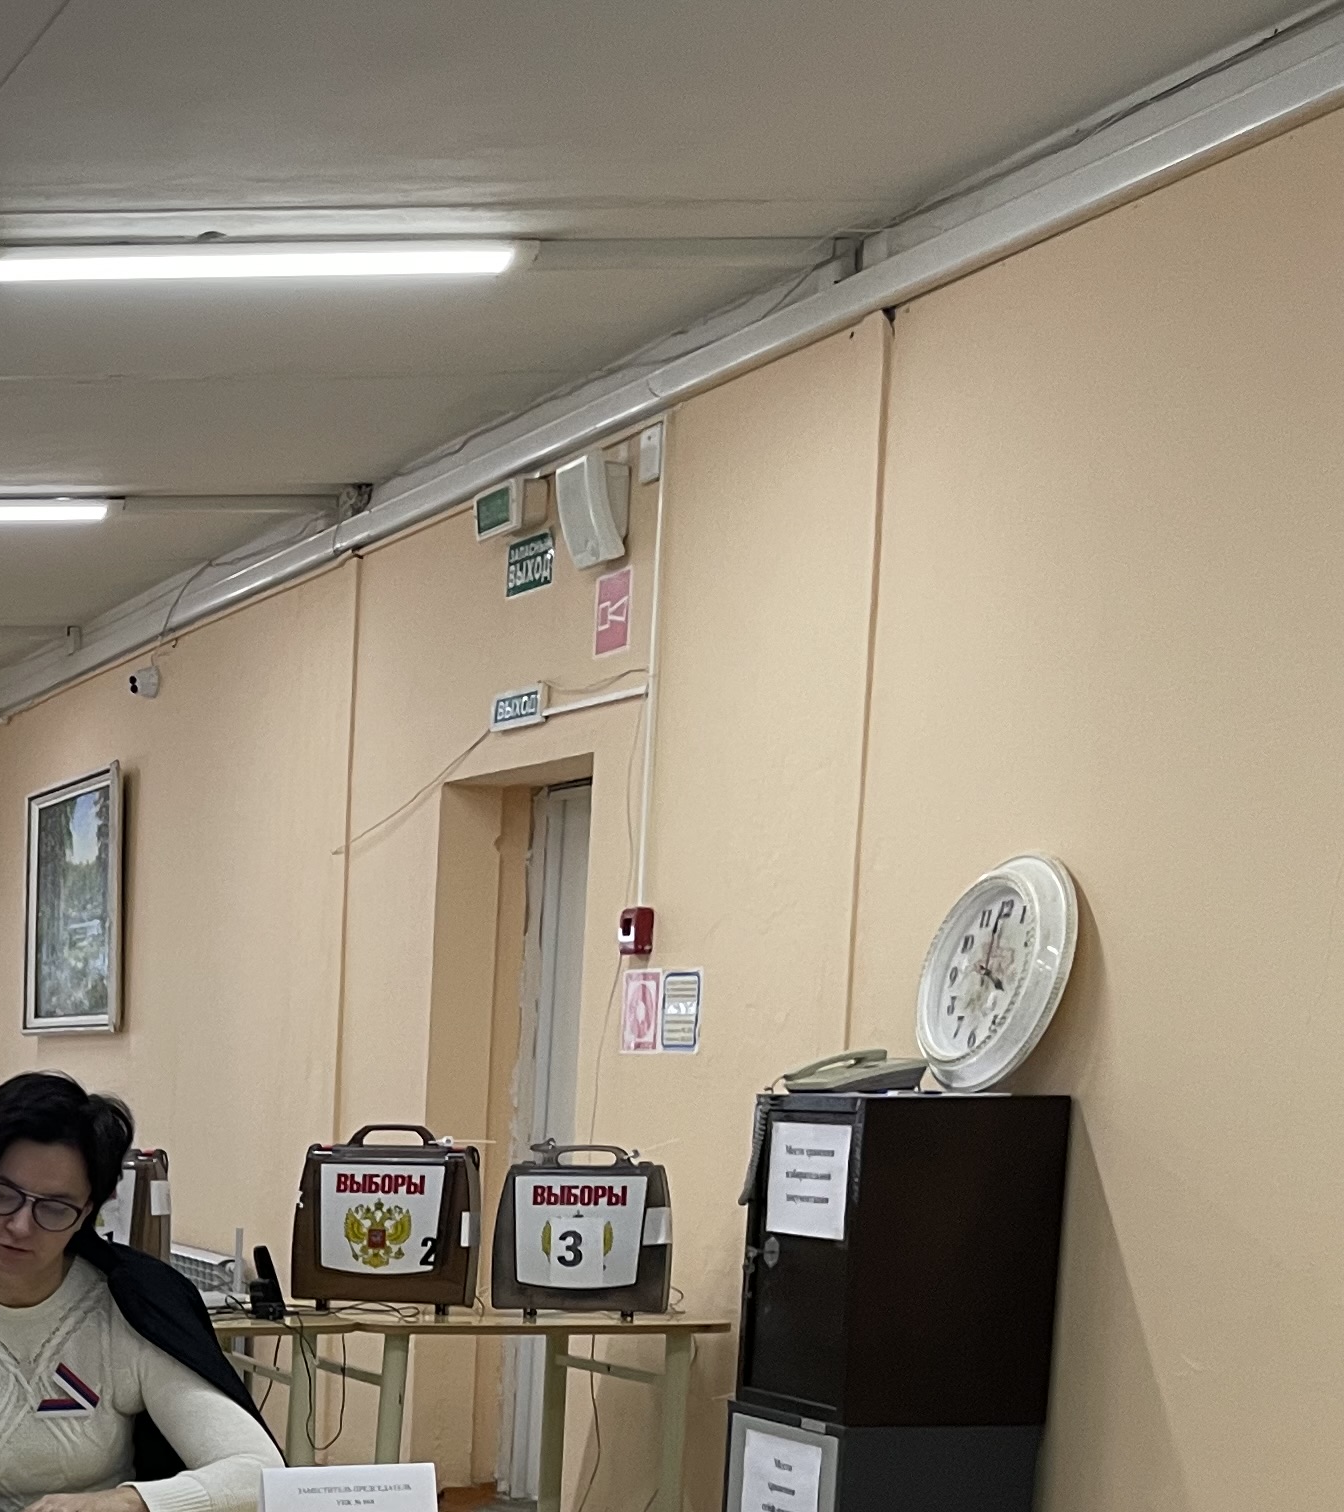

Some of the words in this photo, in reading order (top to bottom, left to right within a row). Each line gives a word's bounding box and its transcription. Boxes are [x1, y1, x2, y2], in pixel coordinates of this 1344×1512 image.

[509, 555, 552, 588] ВЫХОД
[497, 695, 539, 720] ВЫХОД
[336, 1173, 426, 1195] ВЫБОРЫ
[532, 1185, 628, 1207] ВЫБОРЫ
[419, 1236, 437, 1266] 2
[557, 1231, 583, 1267] 3
